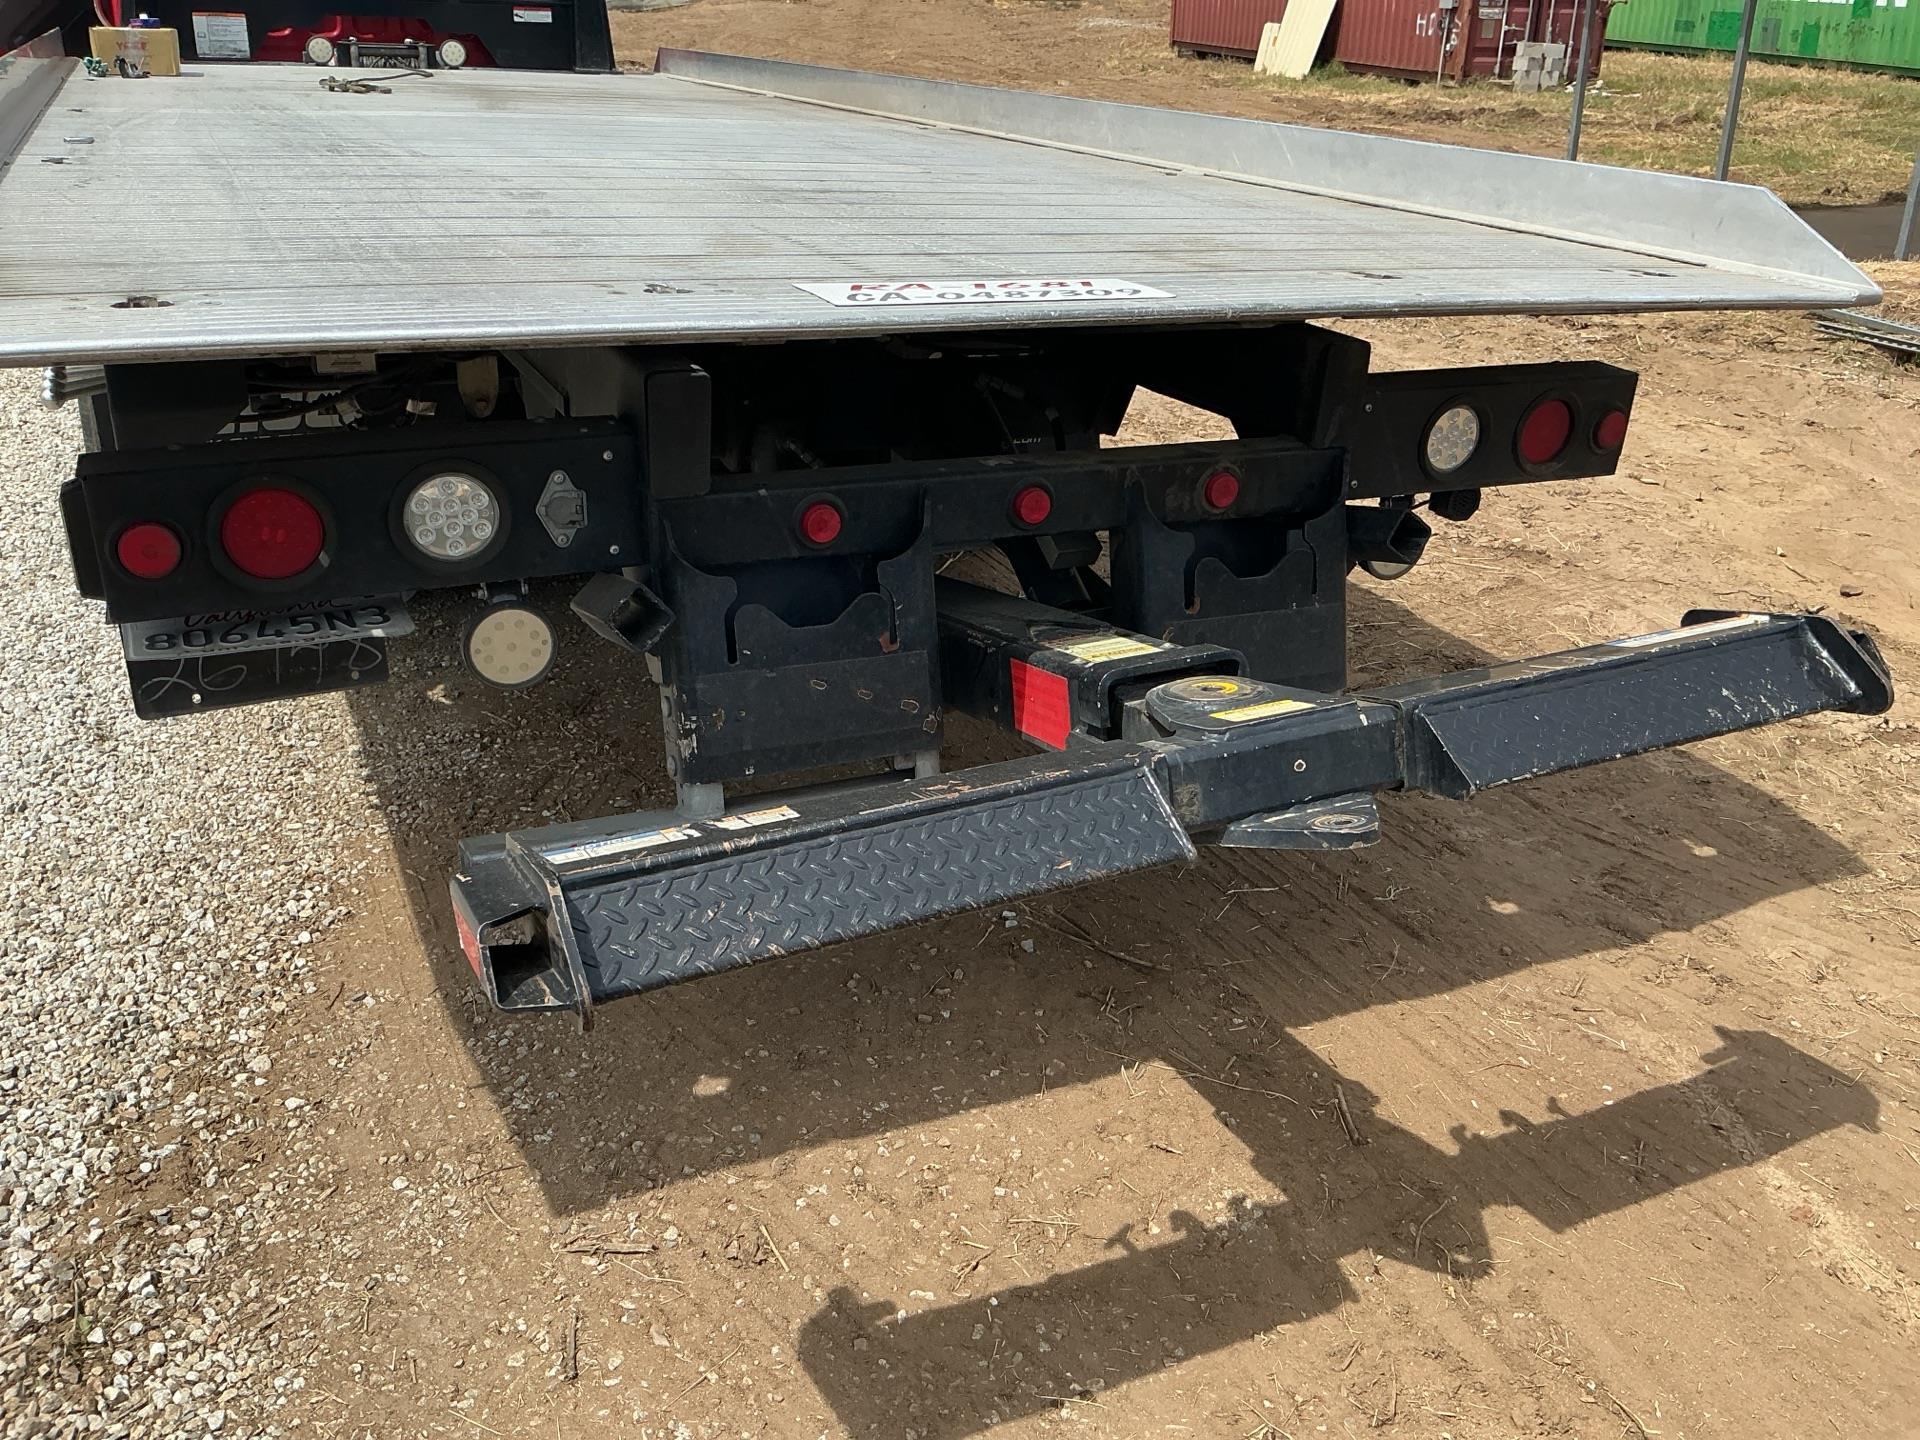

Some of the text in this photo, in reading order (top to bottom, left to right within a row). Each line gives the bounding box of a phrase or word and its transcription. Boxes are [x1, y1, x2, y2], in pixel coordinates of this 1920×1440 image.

[850, 280, 1095, 292] RA-1681
[846, 288, 1142, 302] CA-0487309
[144, 605, 392, 651] 80645N3
